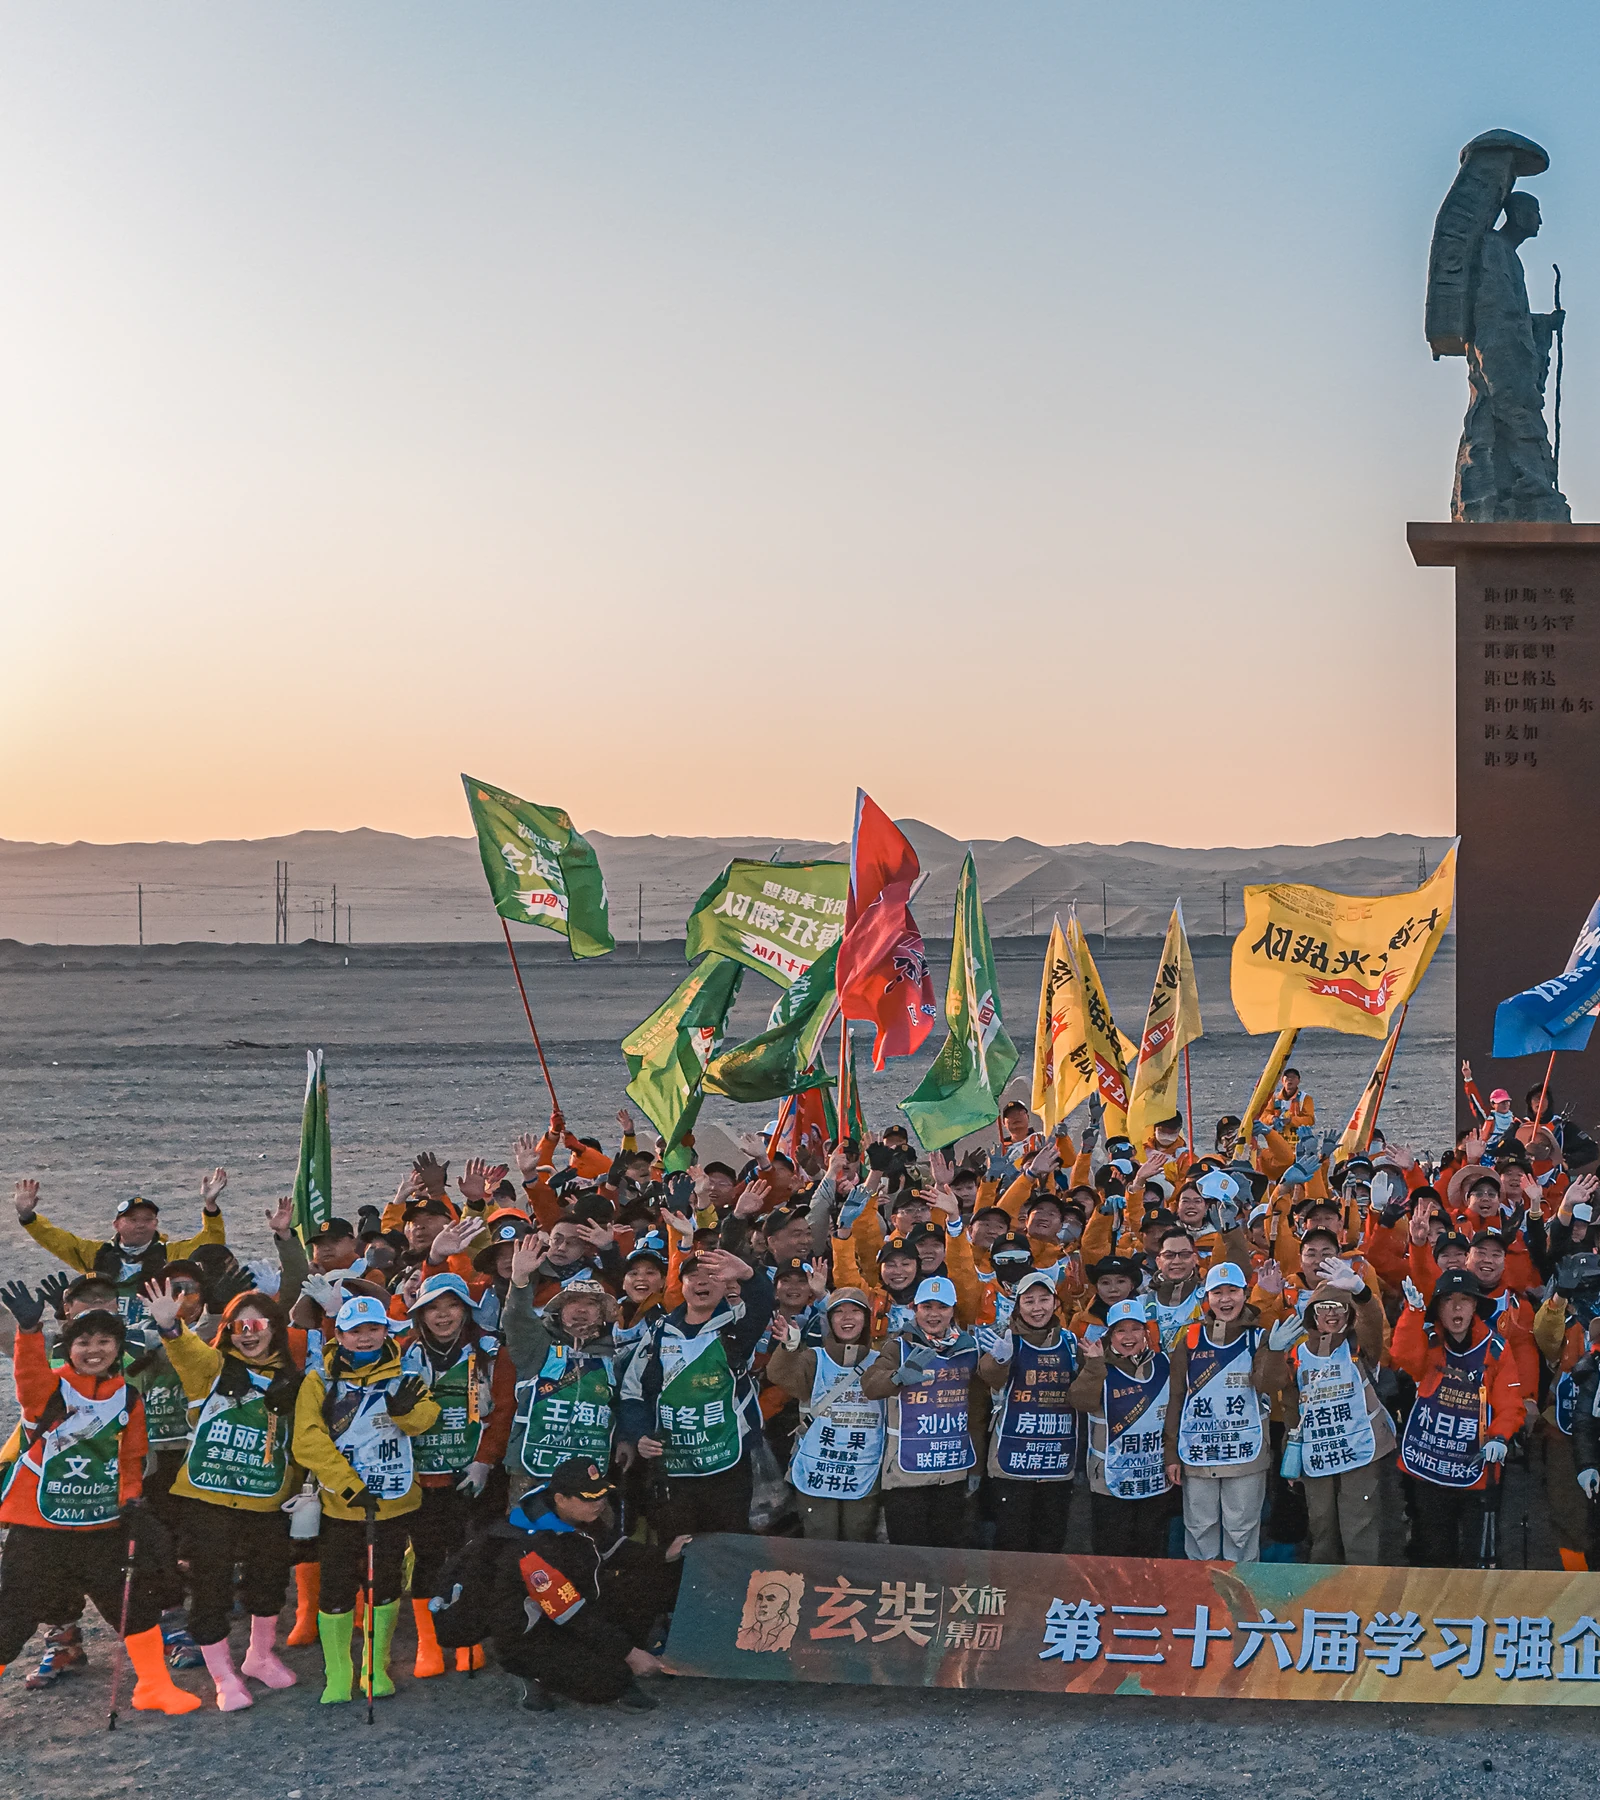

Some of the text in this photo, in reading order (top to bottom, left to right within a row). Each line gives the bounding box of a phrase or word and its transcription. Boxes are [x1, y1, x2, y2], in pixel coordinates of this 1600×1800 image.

[1484, 587, 1576, 605] 距伊斯兰堡
[1484, 643, 1556, 660] 距新德里
[1484, 670, 1556, 687] 距巴格达
[1484, 698, 1594, 714] 距伊斯坦布尔
[1484, 724, 1538, 740] 距麦加
[1484, 752, 1538, 767] 距罗马
[907, 1391, 928, 1404] 36
[1014, 1390, 1032, 1402] 36
[1193, 1395, 1246, 1418] 赵玲
[1015, 1413, 1071, 1435] 房珊珊
[819, 1425, 866, 1451] 果果
[930, 1441, 962, 1452] 知行征途
[1201, 1432, 1240, 1444] 知行征途
[1312, 1439, 1348, 1453] 知行征途
[1025, 1442, 1061, 1453] 知行征途
[1189, 1441, 1254, 1462] 荣誉主席
[916, 1451, 967, 1469] 联席主席
[1009, 1452, 1070, 1470] 联席主席
[1309, 1448, 1357, 1470] 秘书长
[815, 1461, 855, 1476] 知行征途
[194, 1471, 228, 1485] AXM
[807, 1472, 859, 1494] 秘书长
[50, 1508, 85, 1520] AXM
[949, 1584, 1007, 1616] 文旅
[810, 1575, 939, 1648] 玄奘
[944, 1620, 1005, 1652] 集团
